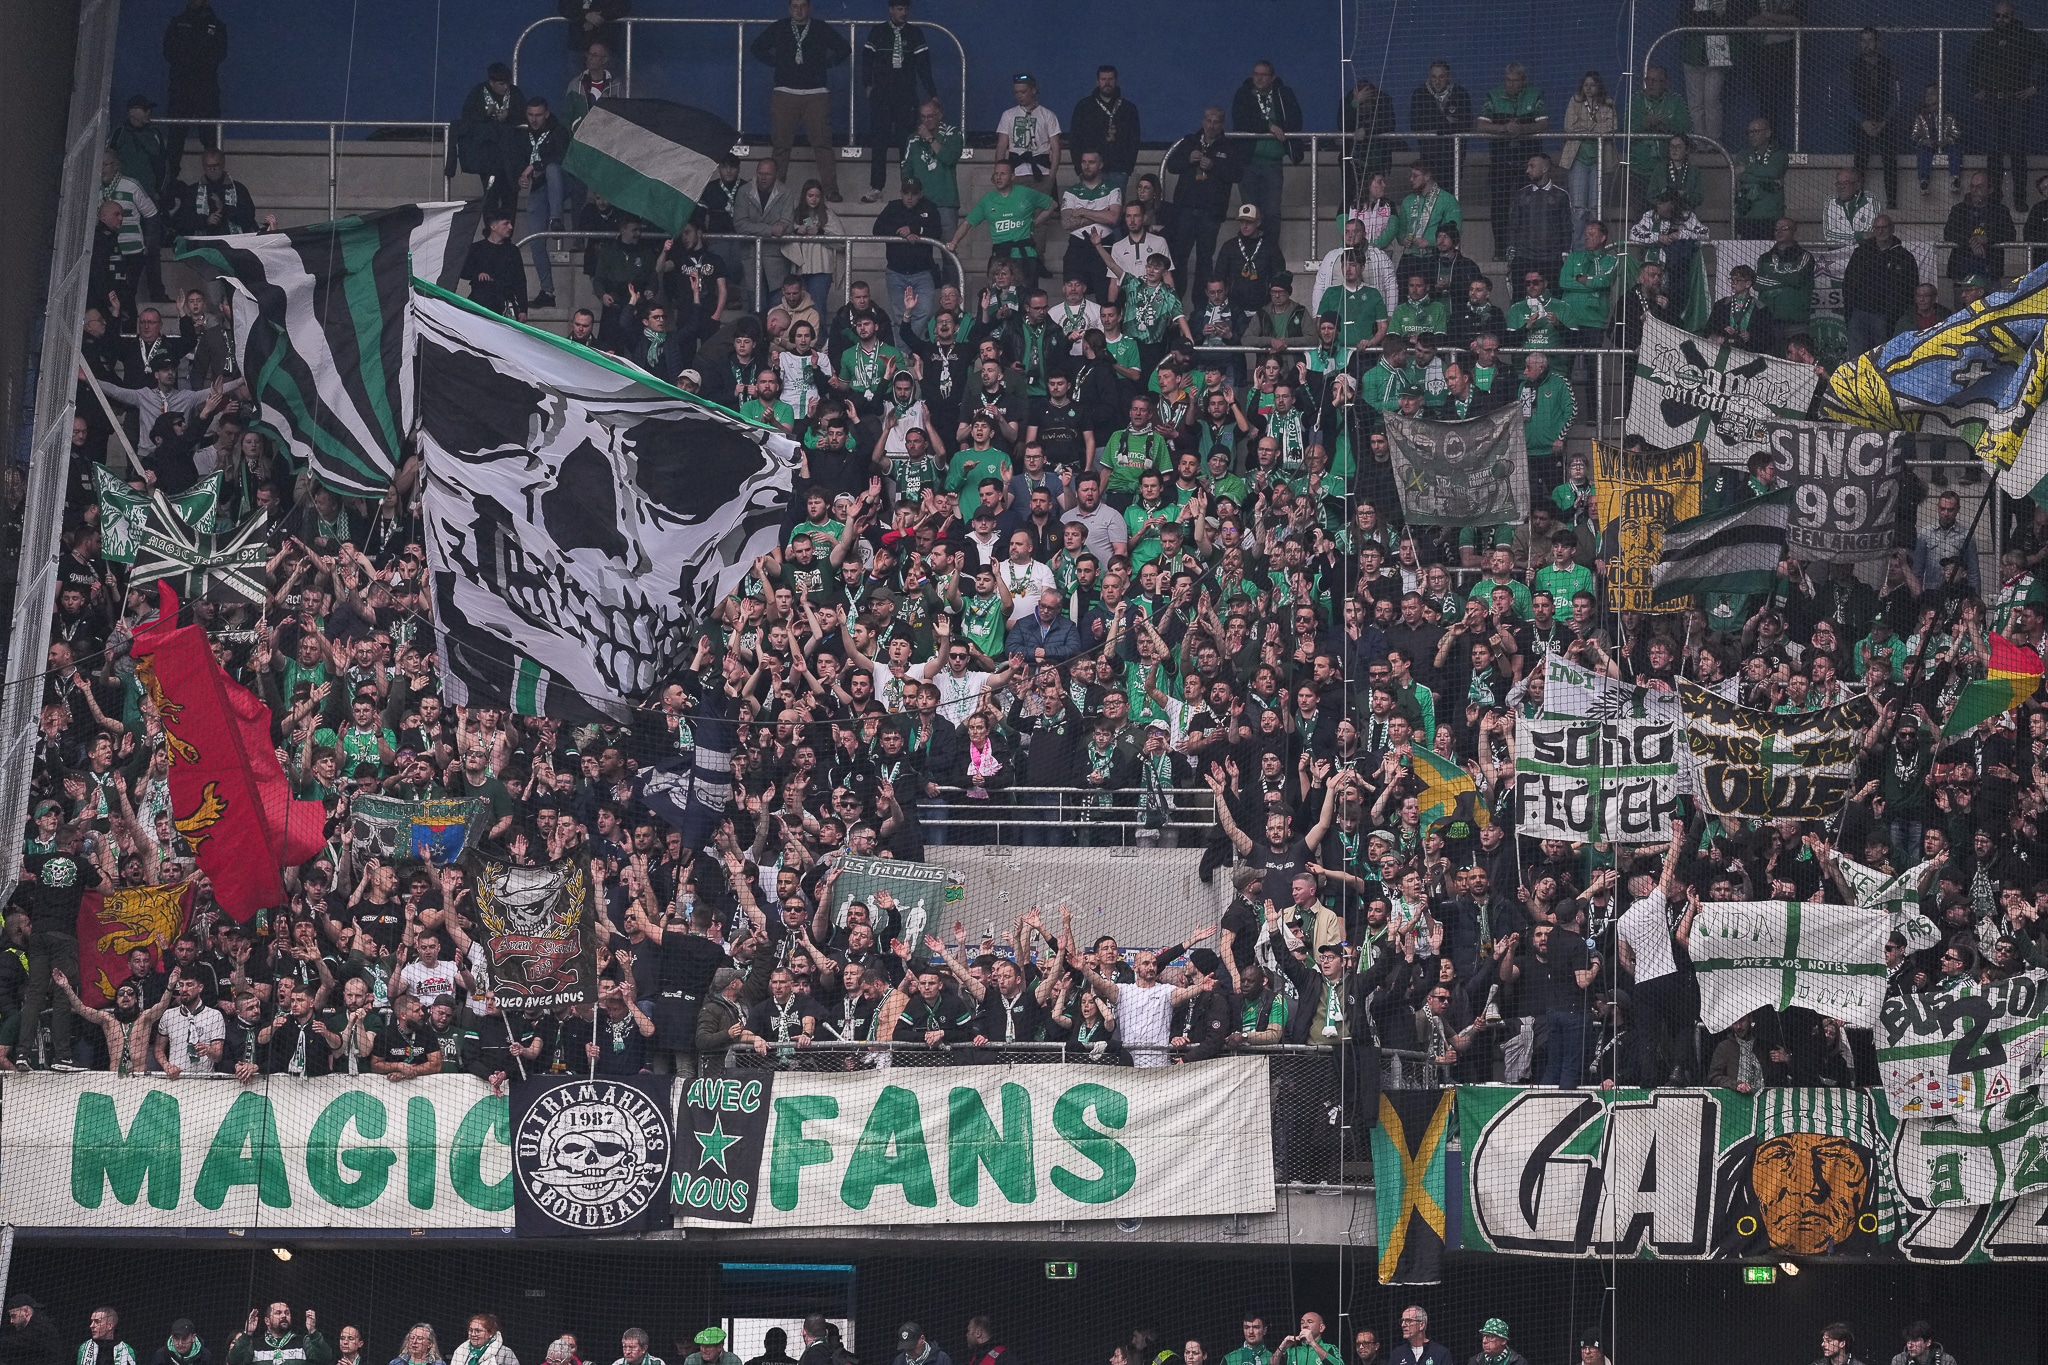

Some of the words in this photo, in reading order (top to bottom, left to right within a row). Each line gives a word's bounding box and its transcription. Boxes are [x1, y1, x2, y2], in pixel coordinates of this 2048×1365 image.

[1600, 444, 1698, 482] WANTED
[1771, 428, 1906, 477] SINCE
[1796, 478, 1900, 532] 992
[1733, 957, 1773, 968] PAYEZ
[1778, 958, 1802, 970] VOS
[1808, 959, 1849, 974] NOTES
[525, 995, 553, 1008] AVEC
[555, 991, 584, 1005] NOUS
[687, 1077, 763, 1114] AVEC
[519, 1083, 665, 1158] ULTRAMARINES
[569, 1111, 615, 1127] 1987
[71, 1089, 516, 1211] MAGIC
[769, 1081, 1138, 1212] FANS
[540, 1174, 656, 1227] BORDEAUX
[669, 1171, 750, 1214] NOUS
